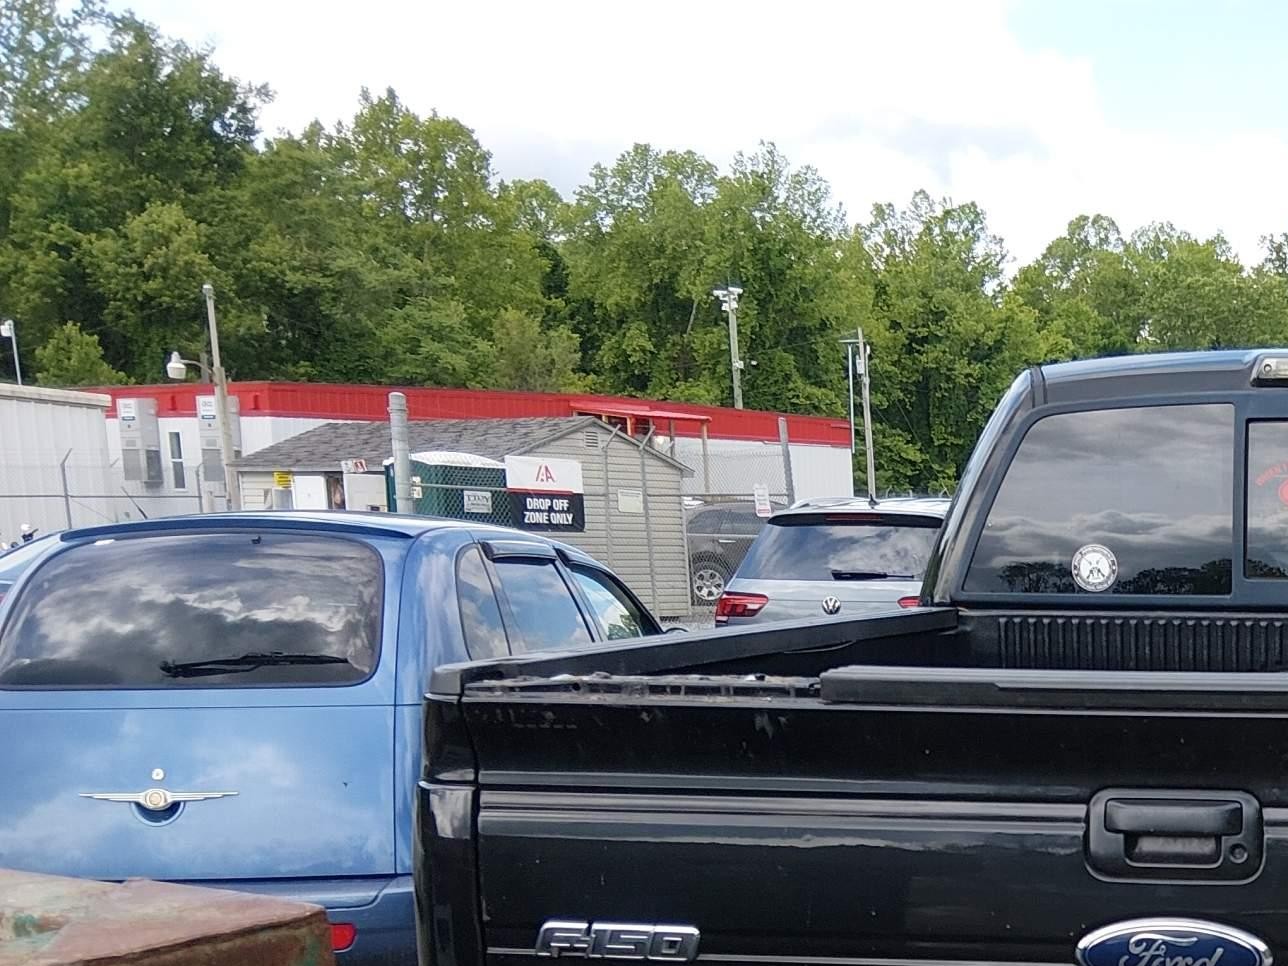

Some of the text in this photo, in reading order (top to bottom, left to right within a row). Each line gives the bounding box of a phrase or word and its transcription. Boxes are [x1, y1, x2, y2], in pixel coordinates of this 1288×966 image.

[526, 497, 569, 511] DROP OFF
[523, 511, 574, 525] ZONE ONLY
